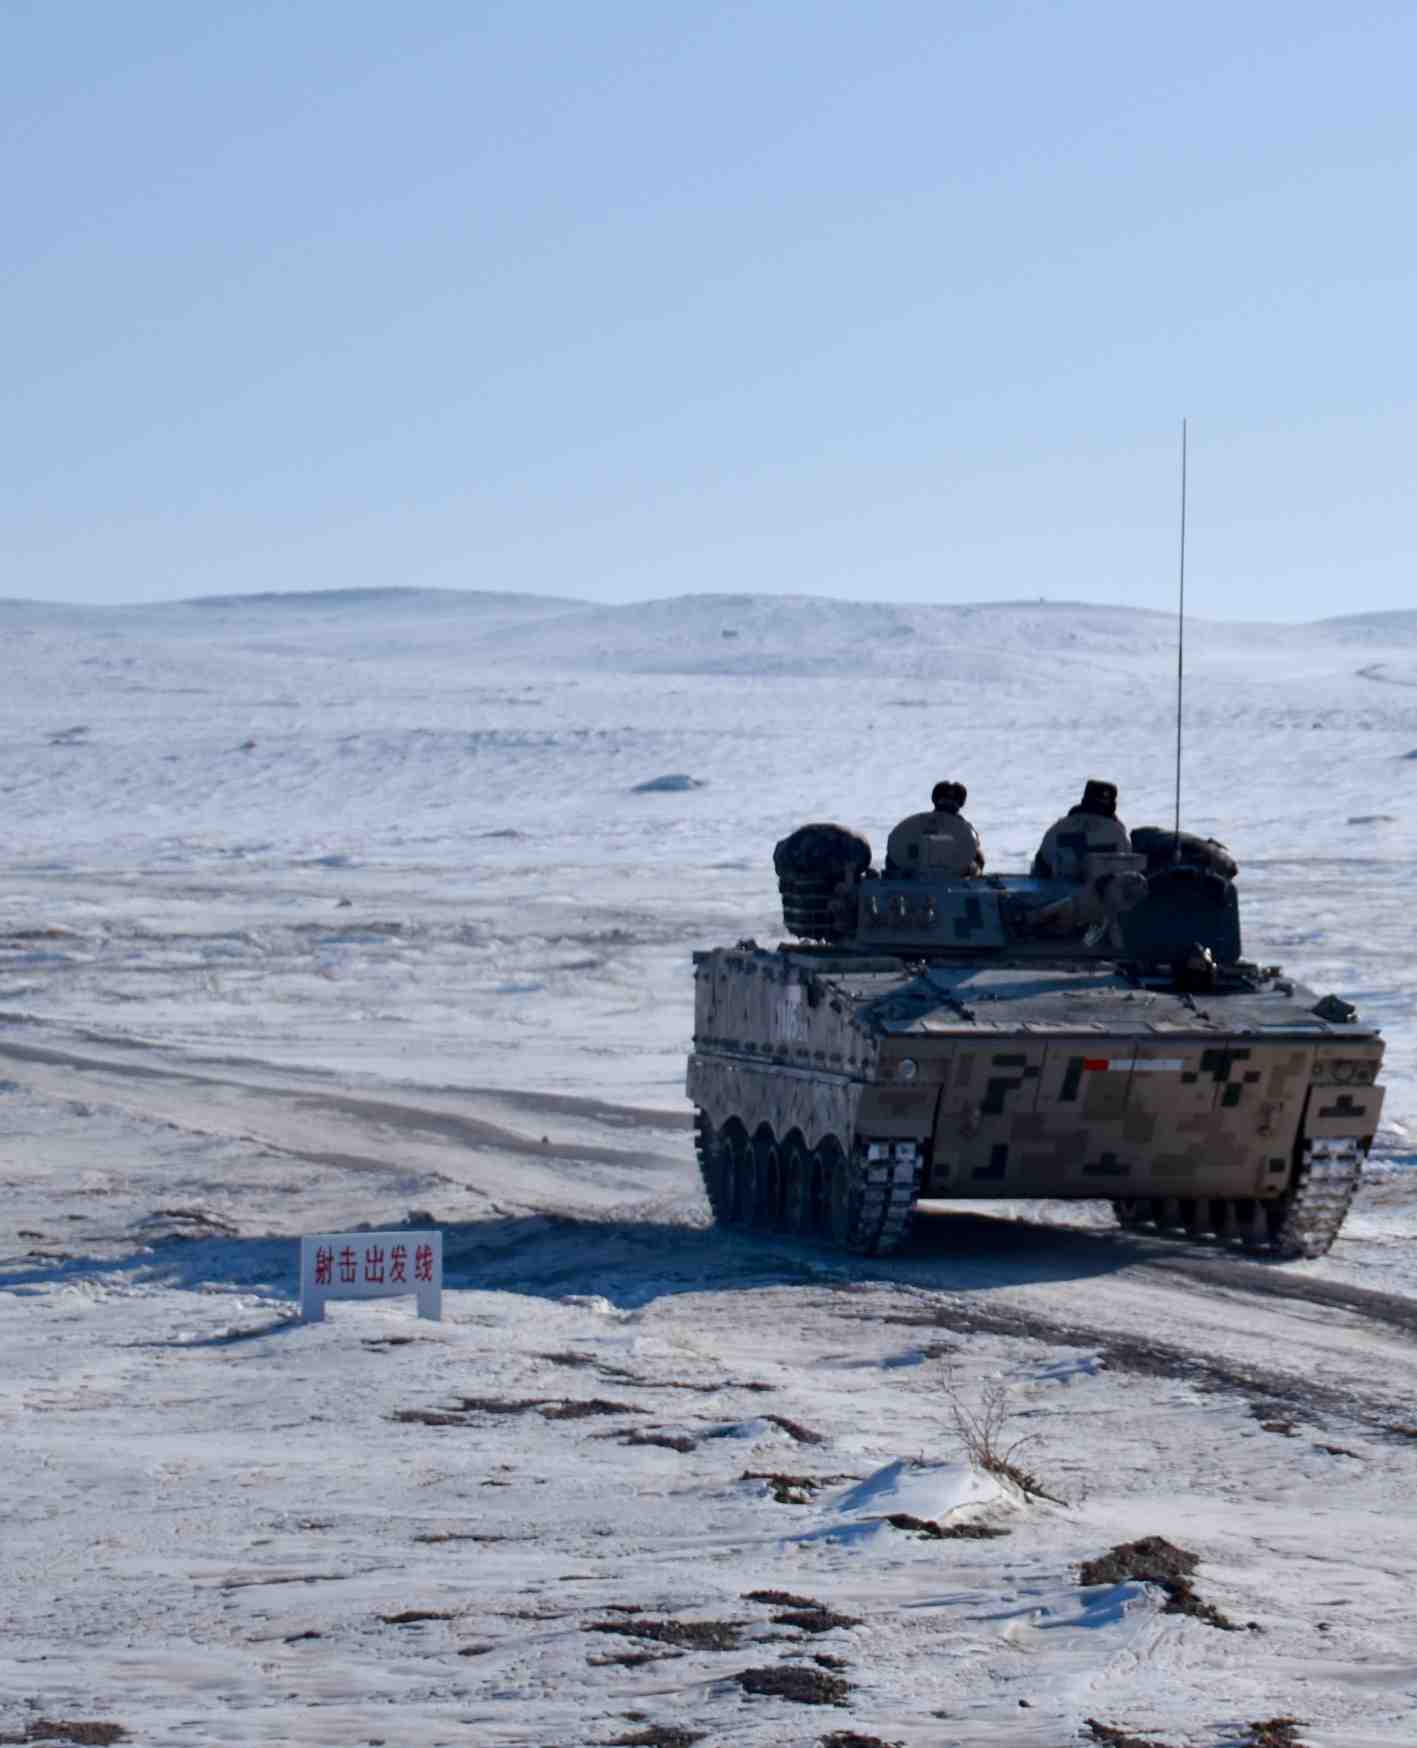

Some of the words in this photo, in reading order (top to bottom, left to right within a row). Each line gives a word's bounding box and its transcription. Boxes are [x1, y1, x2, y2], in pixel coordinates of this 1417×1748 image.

[315, 1243, 432, 1285] 射击出发线
